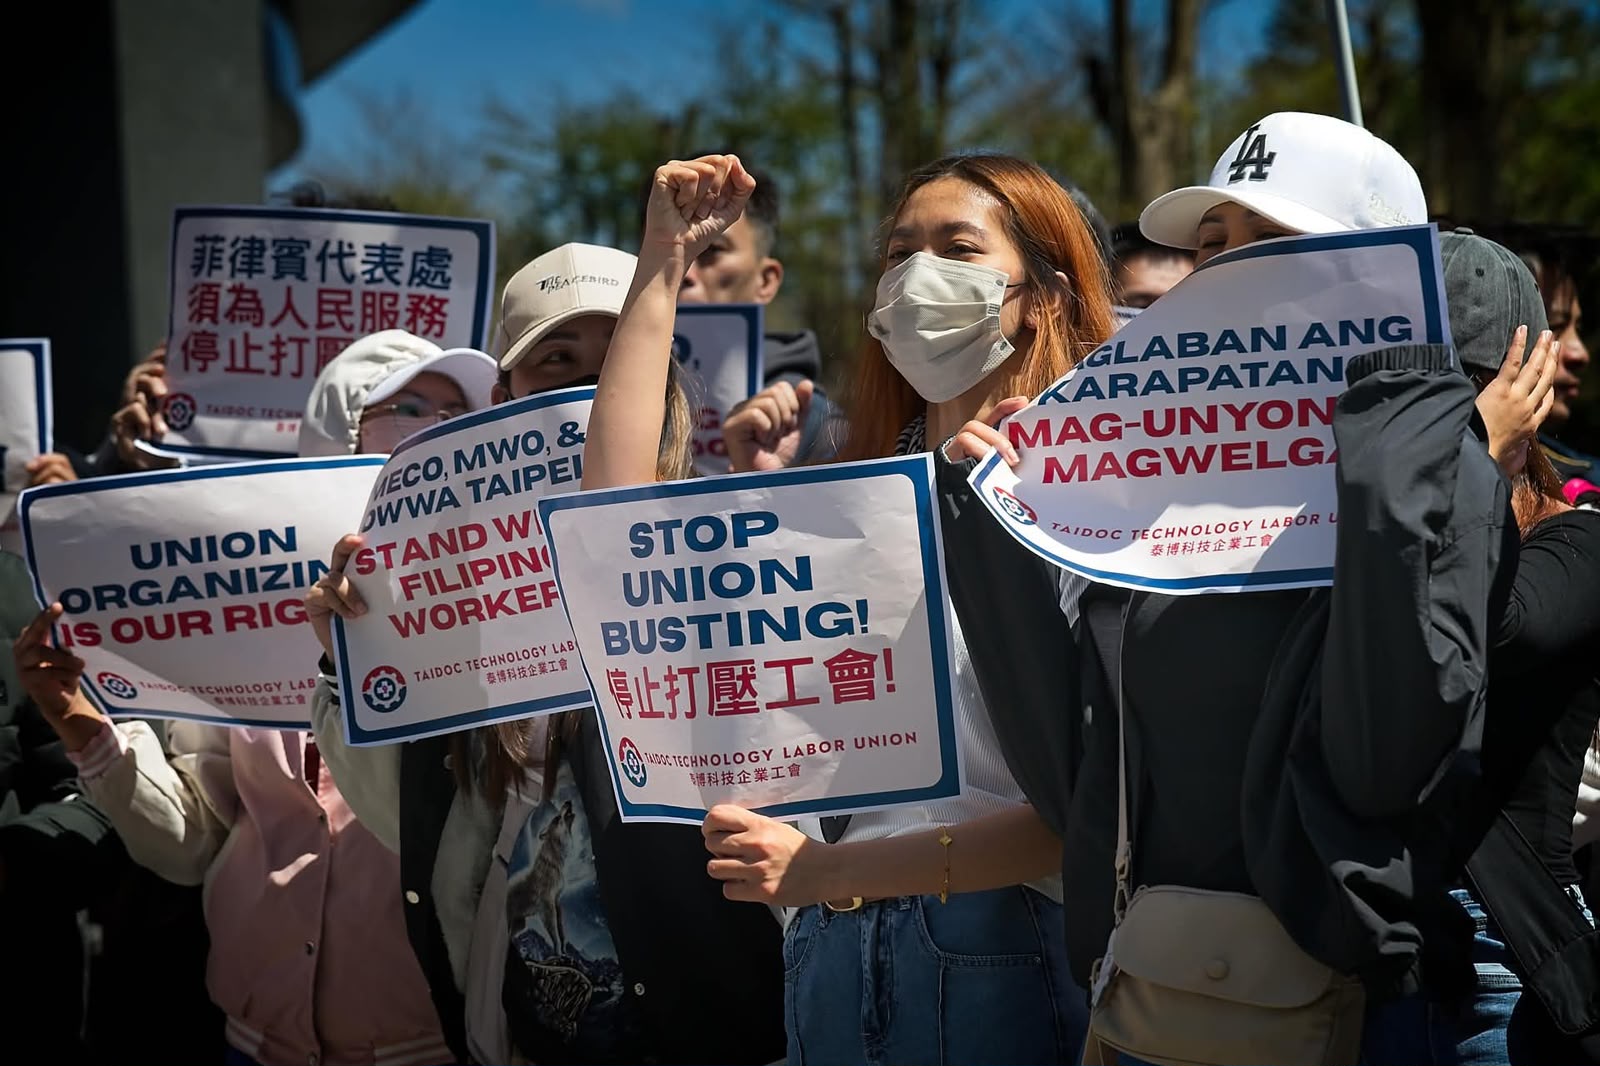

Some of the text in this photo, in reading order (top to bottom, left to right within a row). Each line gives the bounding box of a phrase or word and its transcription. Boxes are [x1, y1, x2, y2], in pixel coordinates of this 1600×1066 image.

[1228, 124, 1276, 183] LA
[191, 235, 453, 290] 菲律賓代表處
[187, 283, 450, 339] 須為人民服務
[1073, 315, 1412, 370] GLABAN ANG
[1037, 355, 1343, 406] KARAPATAN
[454, 430, 551, 475] MWO,
[557, 421, 585, 448] &
[1008, 398, 1334, 449] MAG-UNYON
[465, 454, 582, 503] TAIPEI
[1041, 437, 1338, 484] MAGWELG
[130, 526, 297, 570] UNION
[356, 522, 488, 576] STAND
[629, 510, 779, 558] STOP
[1052, 522, 1122, 540] TAIDOC
[1131, 520, 1252, 540] TECHNOLOGY
[1261, 513, 1320, 530] LABOR
[1150, 534, 1272, 556] 泰博科技企業工會
[622, 555, 813, 607] UNION
[61, 598, 309, 648] IS OUR RIG
[600, 599, 869, 656] BUSTING!
[414, 641, 578, 682] TAIDOC TECHNOLOGY LAB
[486, 659, 568, 685] 泰博科技企業工會
[606, 647, 896, 720] 停止打壓工會!
[190, 682, 282, 696] TECHNOLOGY
[290, 678, 316, 690] LAB
[645, 731, 918, 768] TAIDOC TECHNOLOGY LABOR UNION
